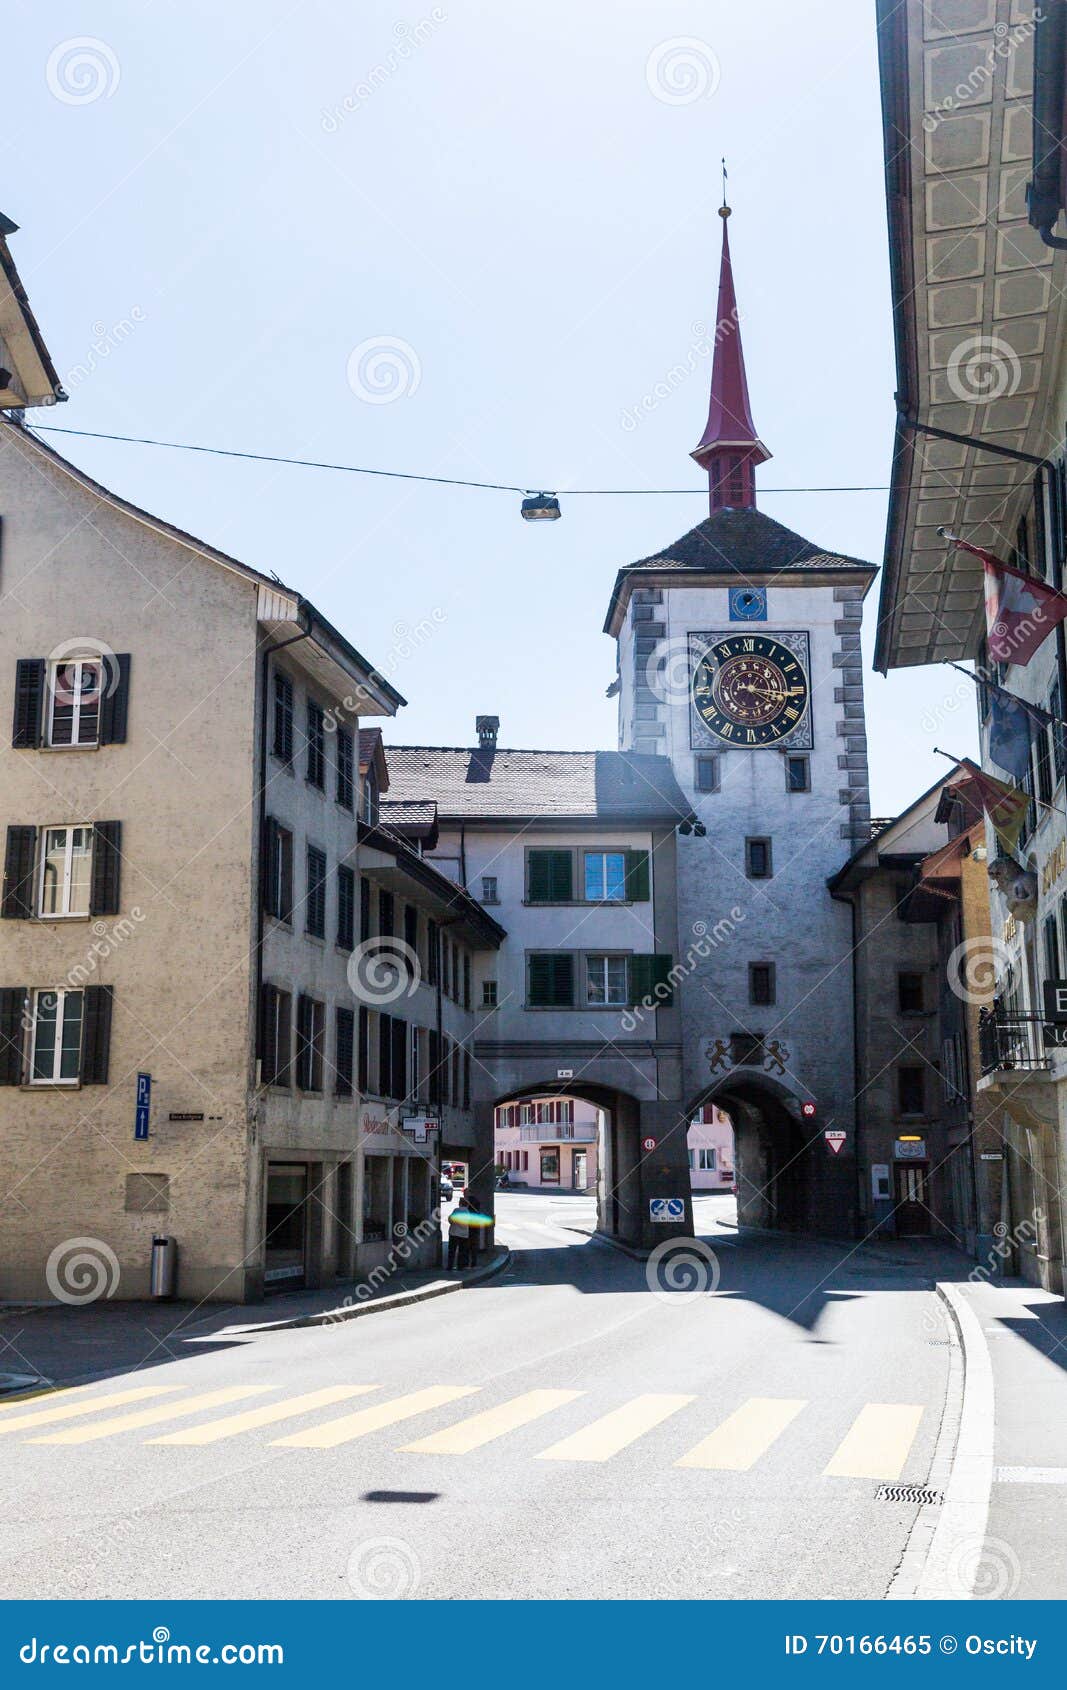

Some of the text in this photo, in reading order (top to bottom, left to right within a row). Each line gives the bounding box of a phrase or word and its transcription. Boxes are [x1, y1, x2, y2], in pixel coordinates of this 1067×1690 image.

[743, 639, 754, 652] XII
[768, 645, 777, 657] I
[784, 662, 797, 673] II
[139, 1077, 147, 1102] P
